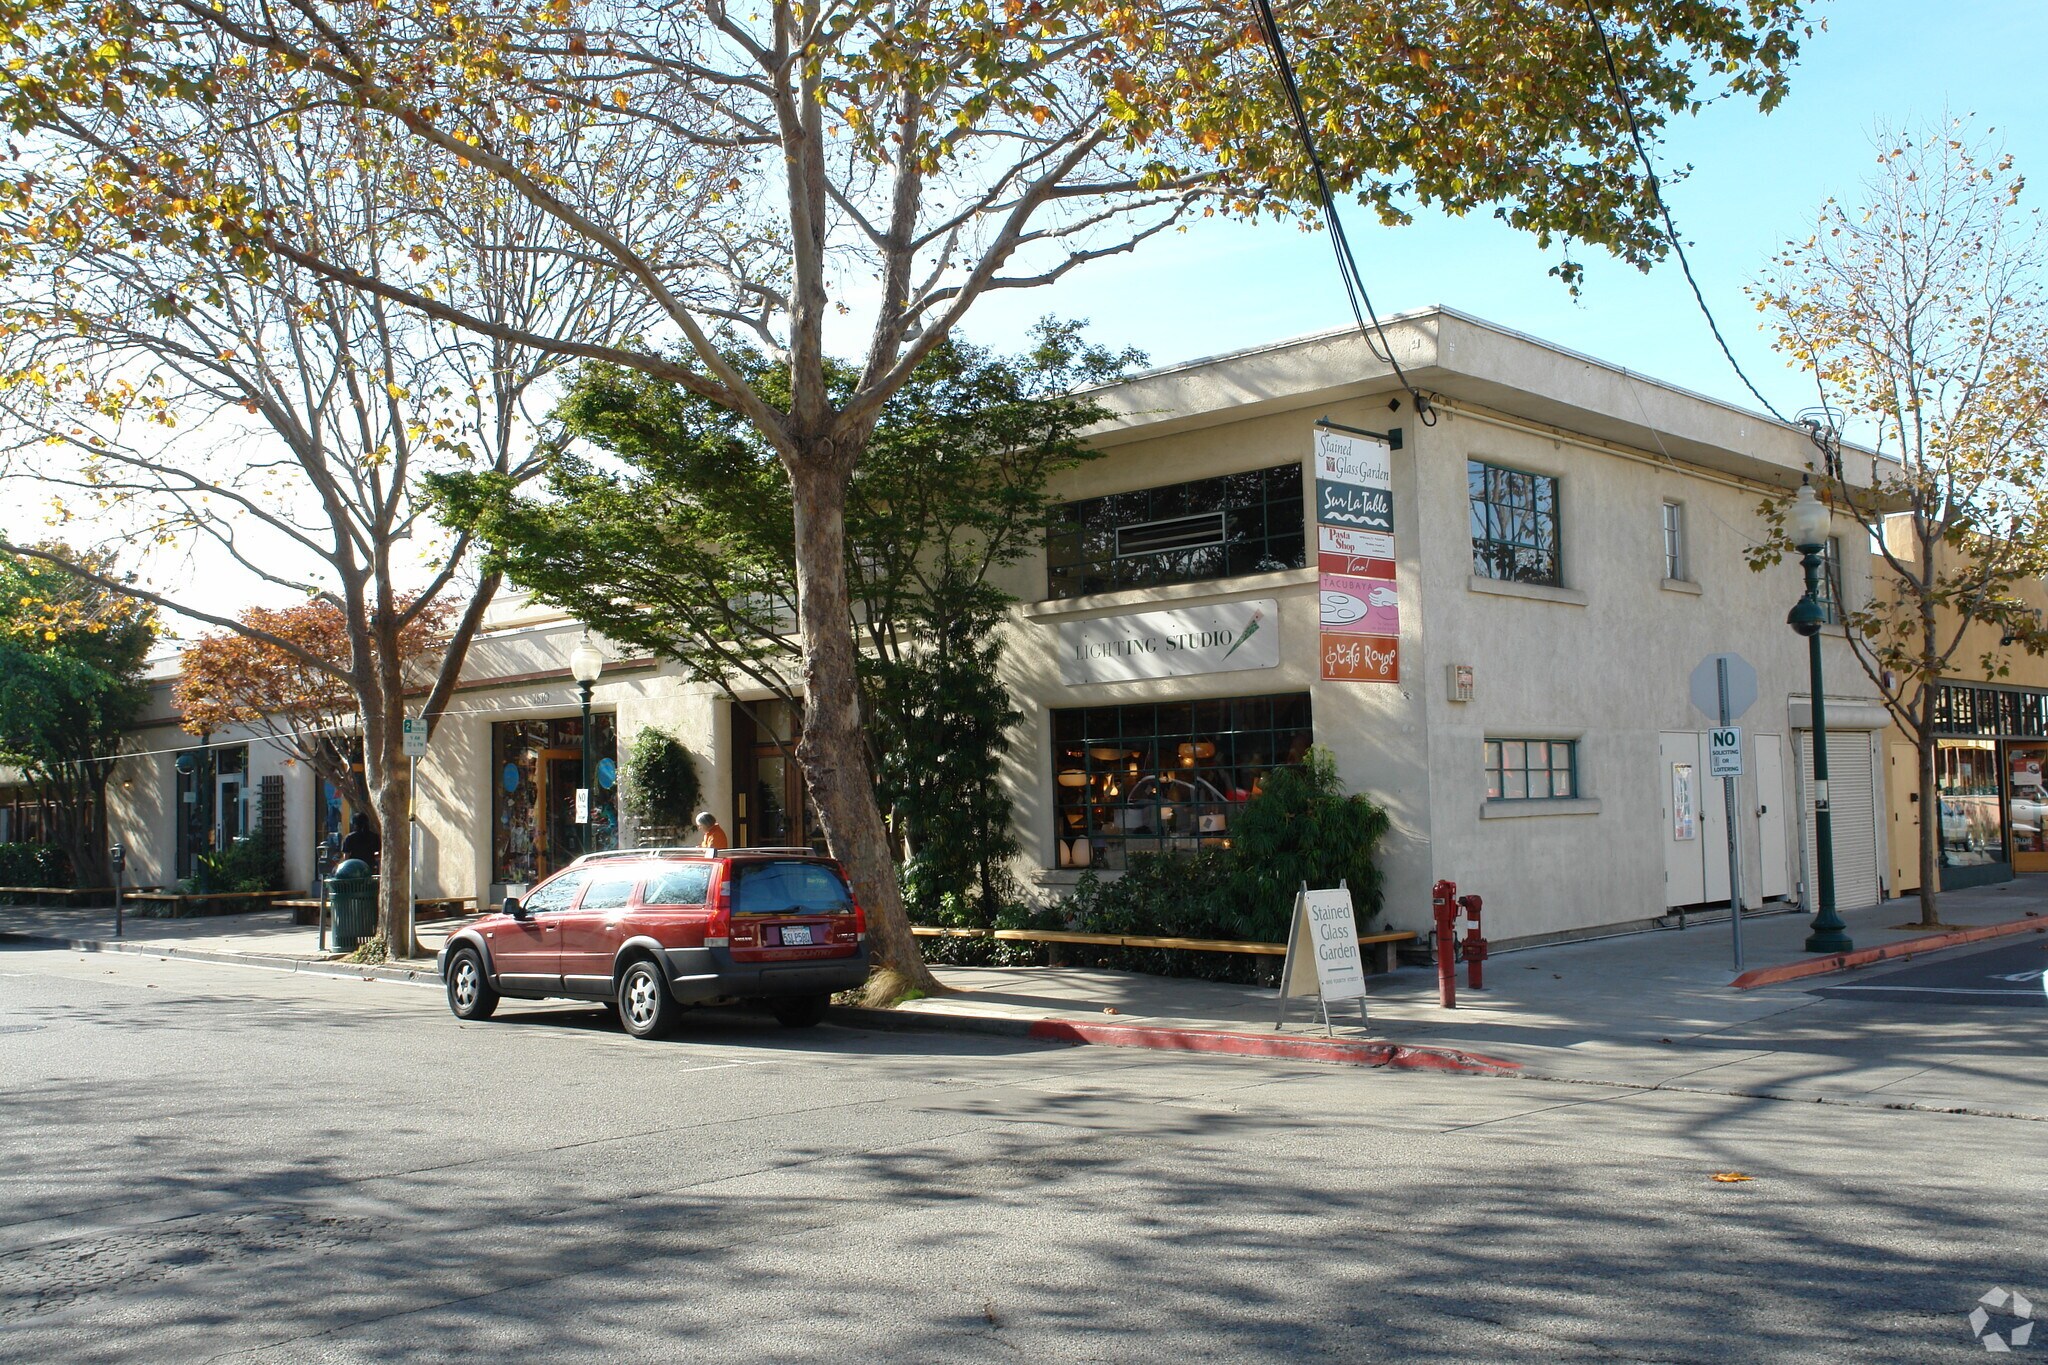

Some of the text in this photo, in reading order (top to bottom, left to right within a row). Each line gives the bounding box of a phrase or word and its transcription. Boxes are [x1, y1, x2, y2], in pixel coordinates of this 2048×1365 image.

[1318, 435, 1352, 457] Stained
[1336, 456, 1389, 483] Glass Garden
[1324, 486, 1388, 514] Sur La Table
[1329, 528, 1350, 541] Pasta
[1335, 538, 1355, 553] Shop
[1324, 578, 1373, 590] TACUBAYA
[1076, 629, 1232, 660] LIGHTING STUDIO
[1364, 645, 1396, 675] Rouge
[1713, 731, 1735, 747] NO
[1312, 903, 1350, 921] Stained
[1320, 923, 1349, 941] Glass
[1319, 943, 1357, 961] Garden
